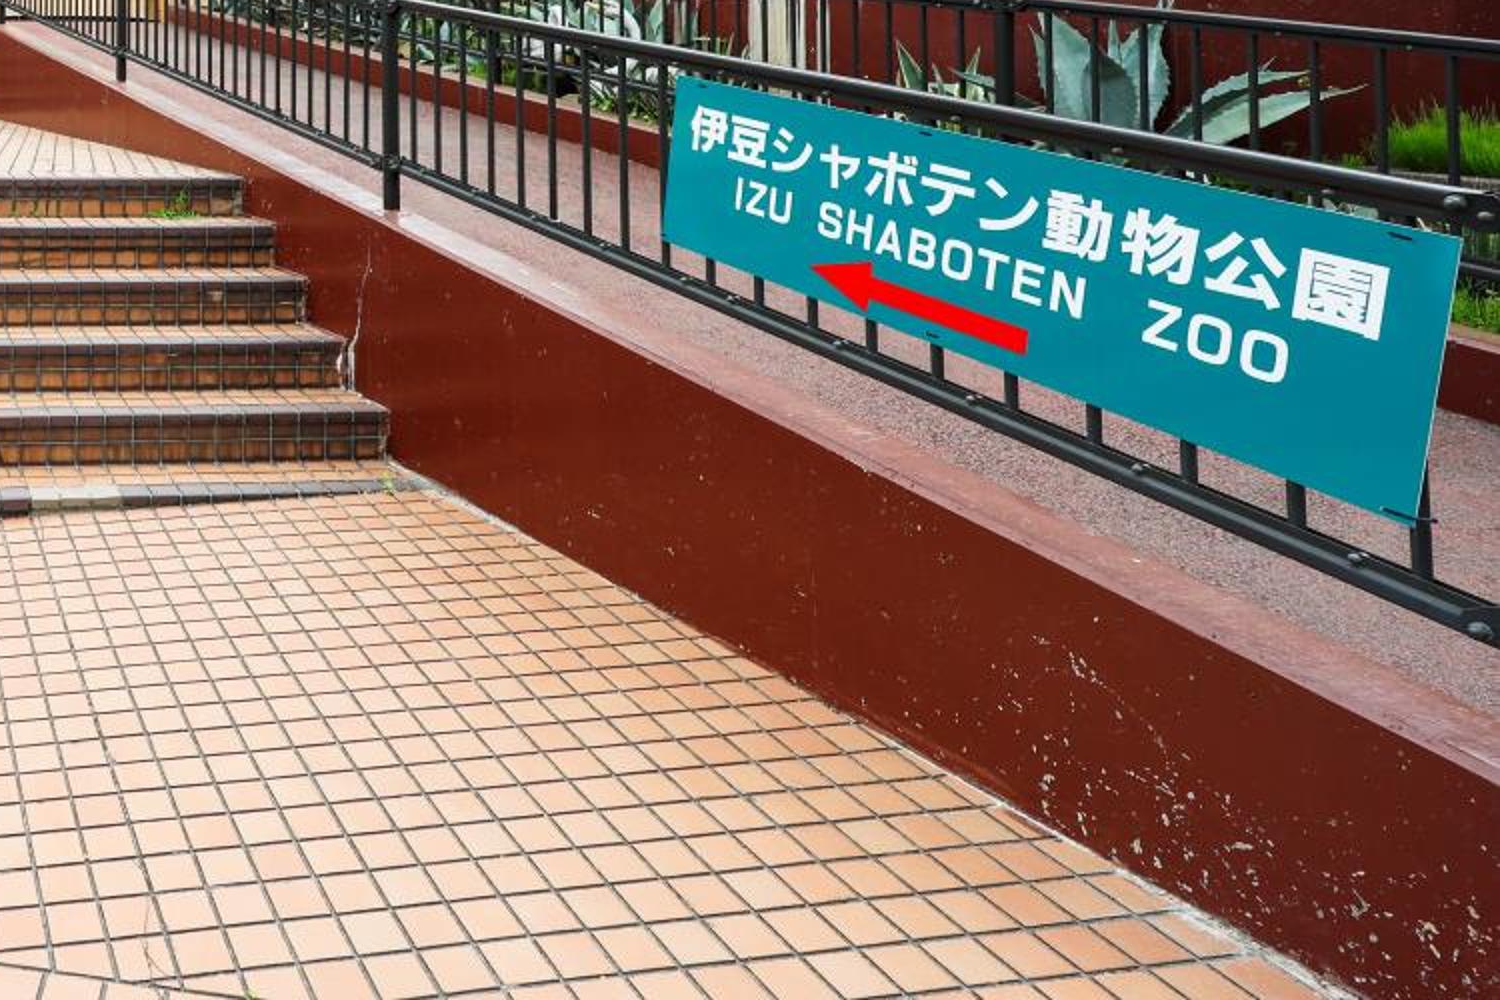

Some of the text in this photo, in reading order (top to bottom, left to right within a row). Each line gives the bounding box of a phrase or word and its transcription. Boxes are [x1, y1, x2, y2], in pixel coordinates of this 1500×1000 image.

[690, 105, 1389, 341] 伊豆シャボテン動物公園
[734, 177, 1289, 384] IZU SHABOTEN ZOO
